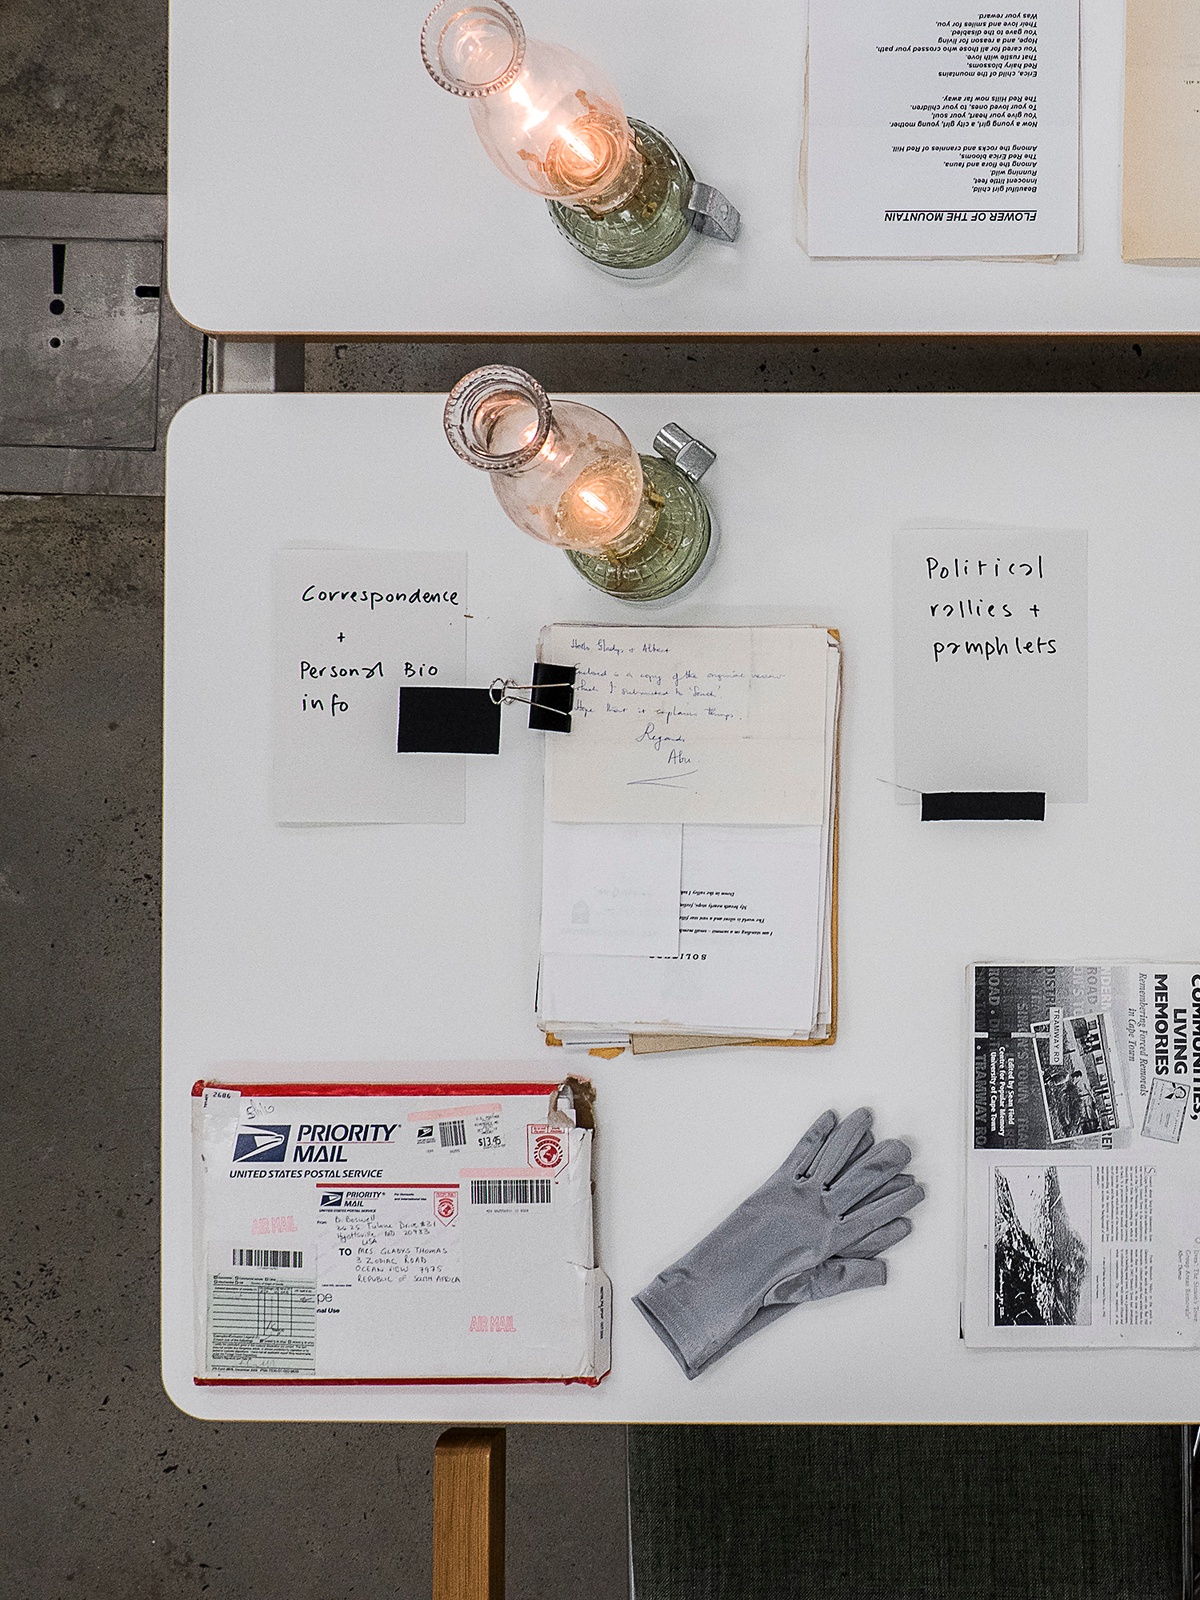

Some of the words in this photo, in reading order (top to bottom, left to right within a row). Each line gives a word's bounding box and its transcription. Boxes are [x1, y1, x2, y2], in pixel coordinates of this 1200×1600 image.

[972, 184, 991, 193] child,
[992, 185, 1004, 193] girl
[884, 213, 943, 221] MOUNTAIN
[946, 213, 967, 221] THE
[971, 213, 986, 221] OF
[989, 213, 1037, 221] FLOWER
[925, 555, 1045, 580] Political
[301, 585, 460, 608] Correspondence
[930, 599, 1013, 618] rallies
[933, 636, 1057, 662] pamphlets
[300, 661, 383, 681] Personal
[404, 661, 439, 678] Bio
[302, 692, 350, 715] info
[1137, 972, 1148, 1028] Remembering
[1128, 1008, 1137, 1017] in
[1126, 1018, 1137, 1038] Cape
[1154, 974, 1169, 1076] MEMORIES
[1139, 1029, 1148, 1056] Forced
[1173, 1008, 1187, 1075] LIVING
[1053, 1051, 1060, 1063] RD
[1128, 1041, 1137, 1062] Town
[989, 1052, 997, 1085] University
[1139, 1058, 1149, 1097] Removals
[975, 1054, 987, 1123] TRAMWAY
[990, 1086, 997, 1094] of
[1006, 1080, 1015, 1089] by
[989, 1095, 997, 1111] Cape
[997, 1081, 1006, 1108] Popular
[997, 1109, 1006, 1136] Memory
[297, 1124, 398, 1142] PRIORITY
[293, 1145, 348, 1163] MAIL
[229, 1169, 267, 1179] UNITED
[268, 1169, 303, 1179] STATES
[304, 1169, 341, 1179] POSTAL
[342, 1169, 383, 1179] SERVICE
[344, 1200, 364, 1208] MAIL
[345, 1191, 382, 1199] PRIORITY
[251, 1218, 271, 1235] AIR
[271, 1215, 298, 1234] MAIL
[339, 1248, 352, 1256] TO
[469, 1315, 488, 1333] AIR
[489, 1315, 517, 1333] MAIL
